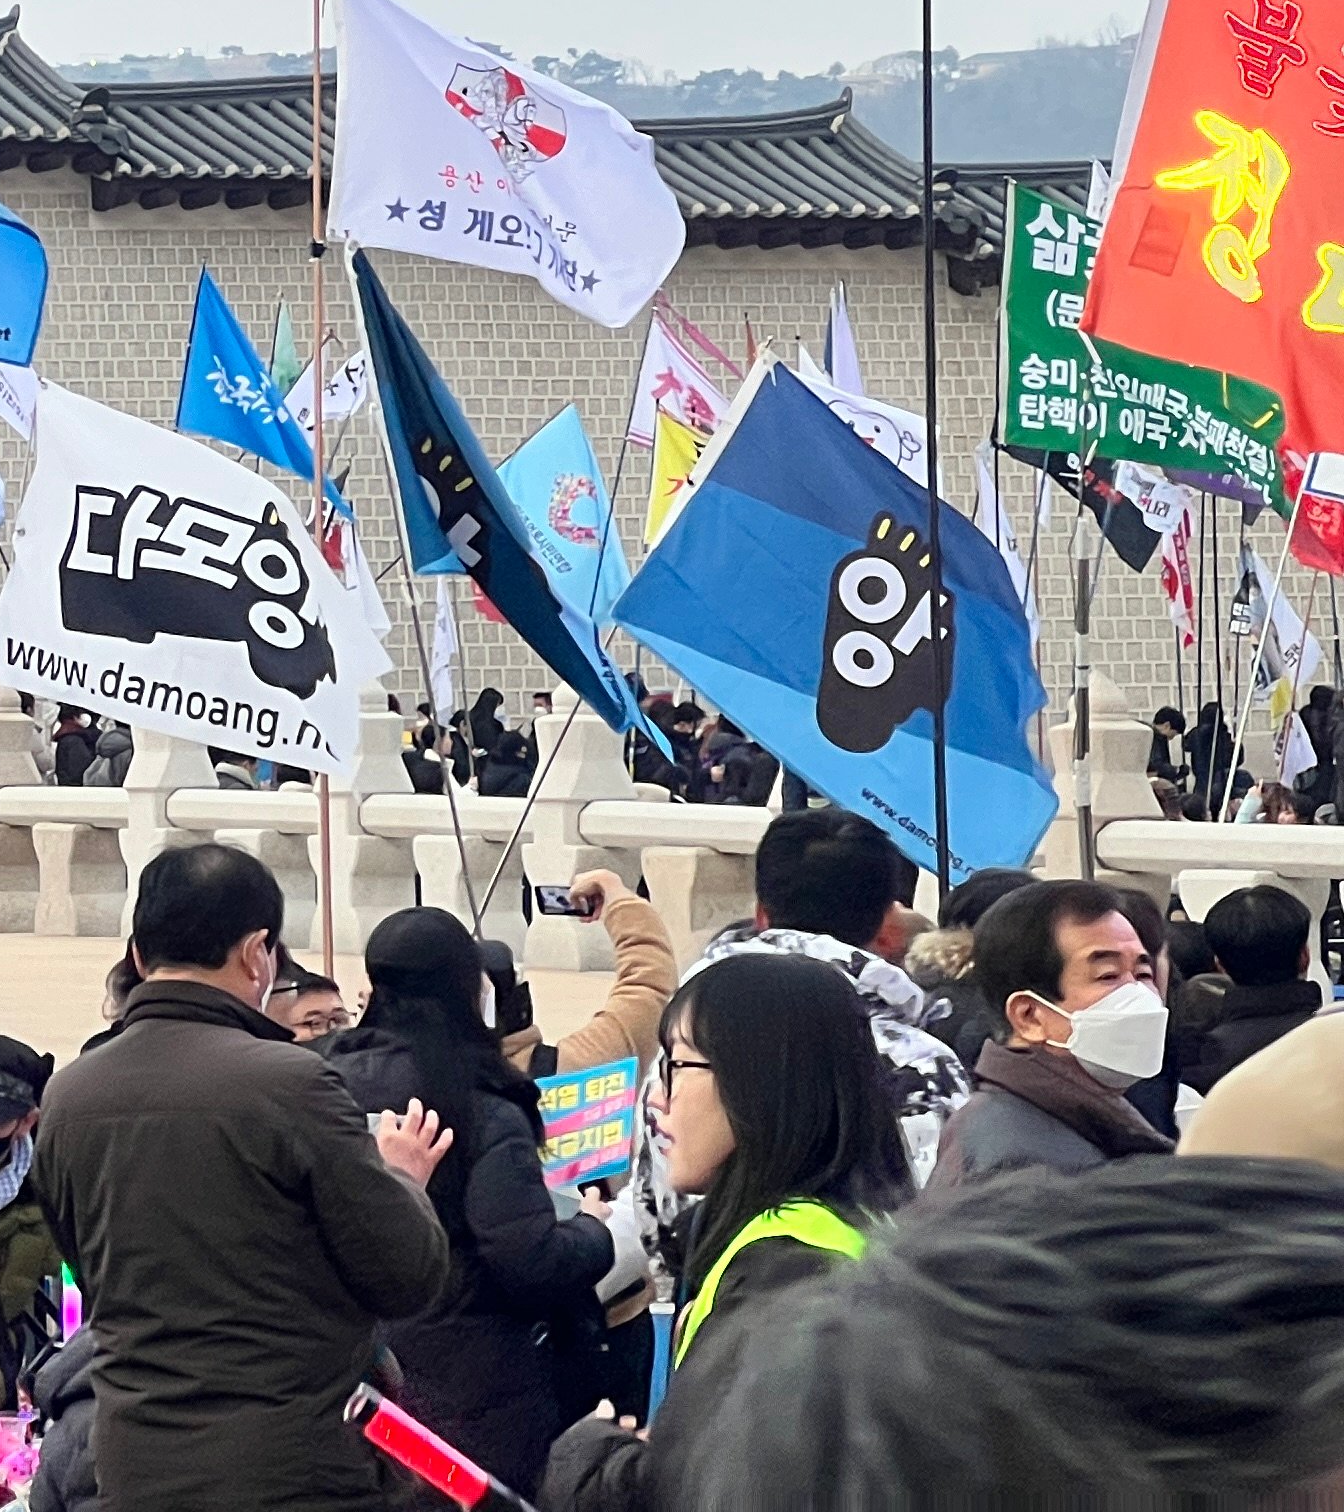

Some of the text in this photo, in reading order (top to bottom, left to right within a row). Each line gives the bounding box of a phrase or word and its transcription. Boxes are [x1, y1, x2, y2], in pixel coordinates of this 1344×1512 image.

[1017, 392, 1109, 439] 탄핵이
[832, 556, 949, 688] 앙
[6, 636, 341, 762] www.damoang.n
